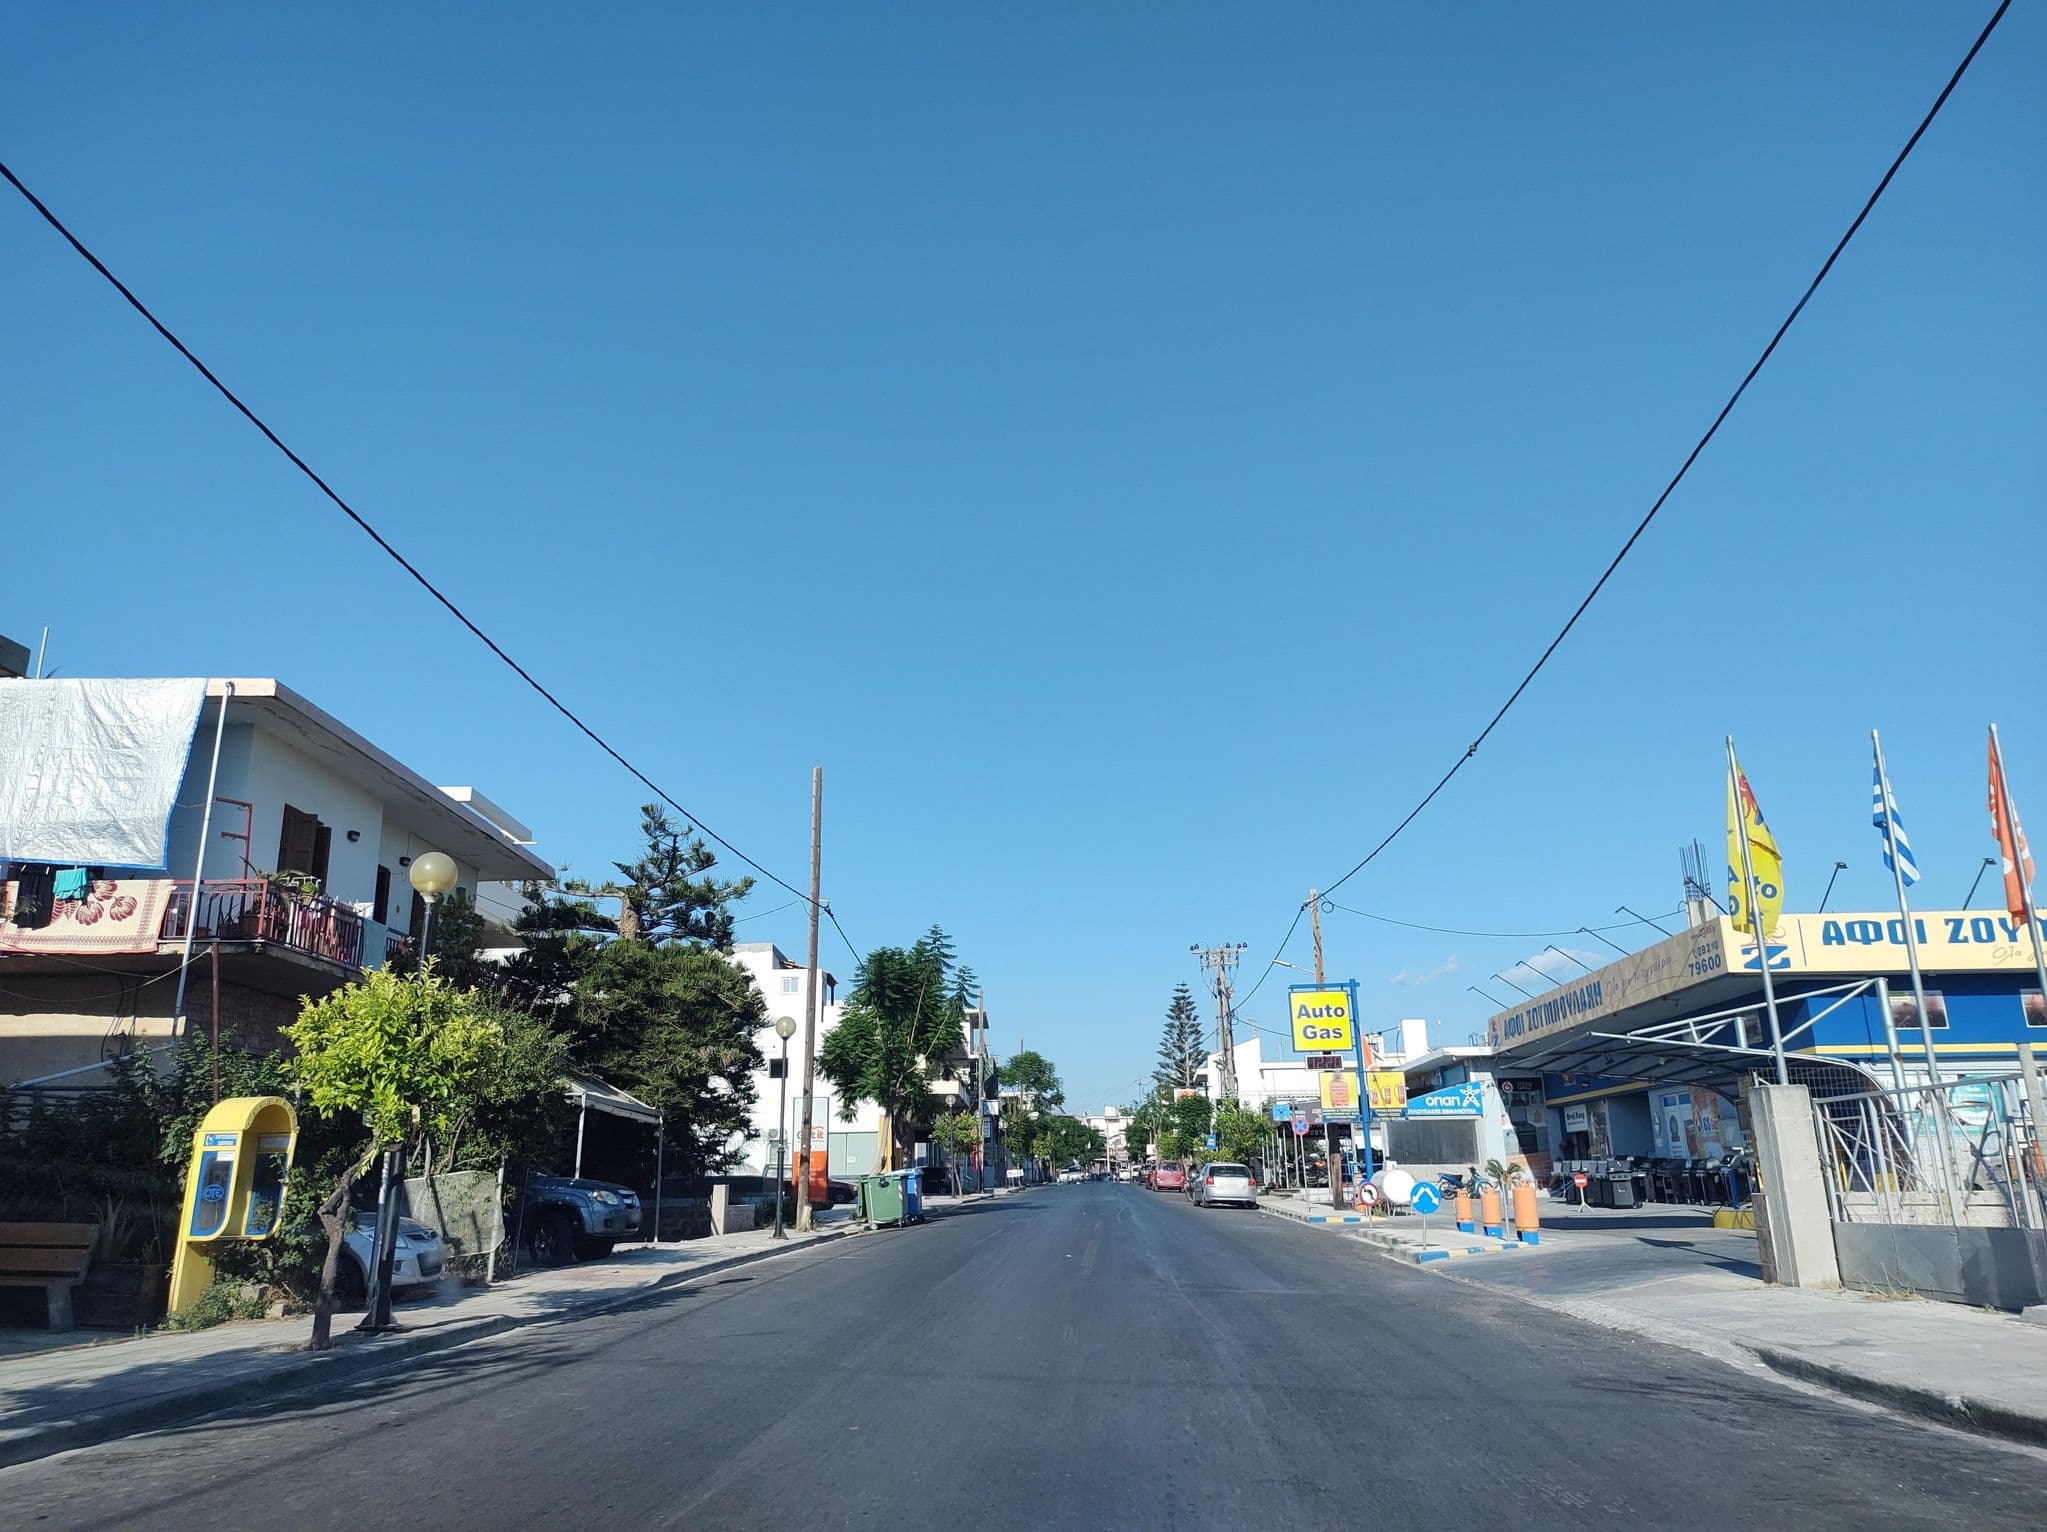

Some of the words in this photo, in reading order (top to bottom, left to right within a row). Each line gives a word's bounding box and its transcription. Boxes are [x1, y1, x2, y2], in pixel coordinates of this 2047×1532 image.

[1822, 918, 1927, 946] ΑΦΟΙ
[1944, 916, 2047, 944] ΖΟΥ
[1688, 954, 1721, 978] 79600
[1297, 1004, 1345, 1019] Auto
[1303, 1025, 1343, 1040] Gas
[1503, 1013, 1526, 1041] ΑΦΟΙ
